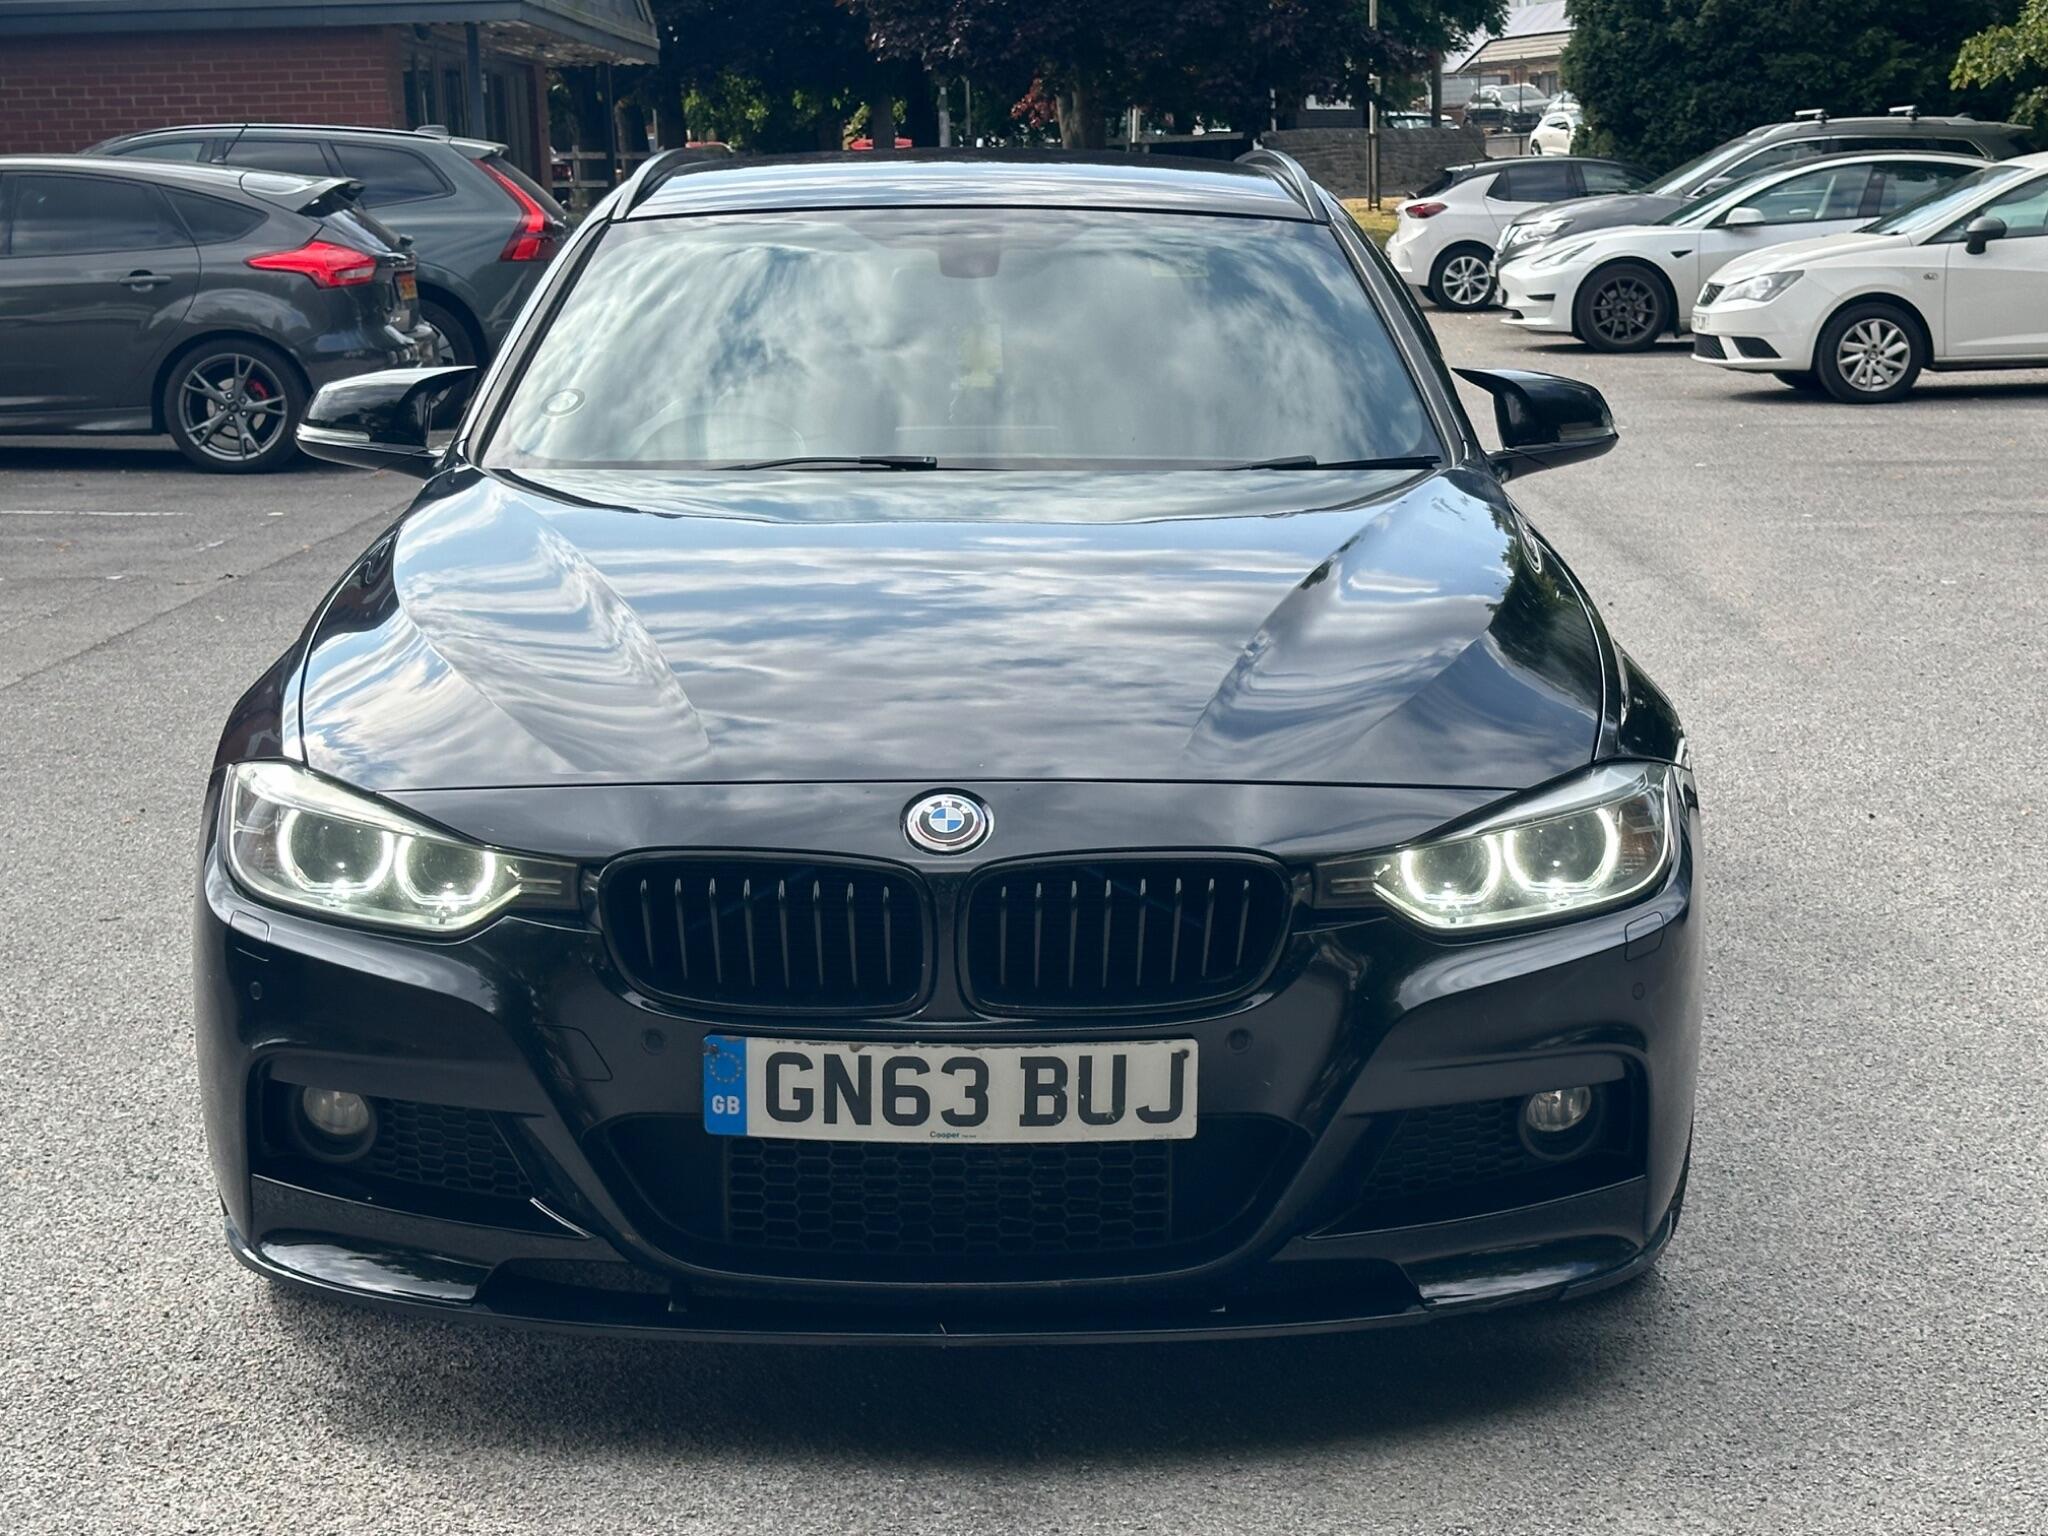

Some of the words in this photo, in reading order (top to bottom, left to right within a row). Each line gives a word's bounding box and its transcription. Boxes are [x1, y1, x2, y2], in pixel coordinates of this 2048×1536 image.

[766, 1051, 989, 1127] GN63
[1019, 1052, 1185, 1127] BUJ
[711, 1095, 740, 1115] GB
[930, 1131, 960, 1139] Cooper
